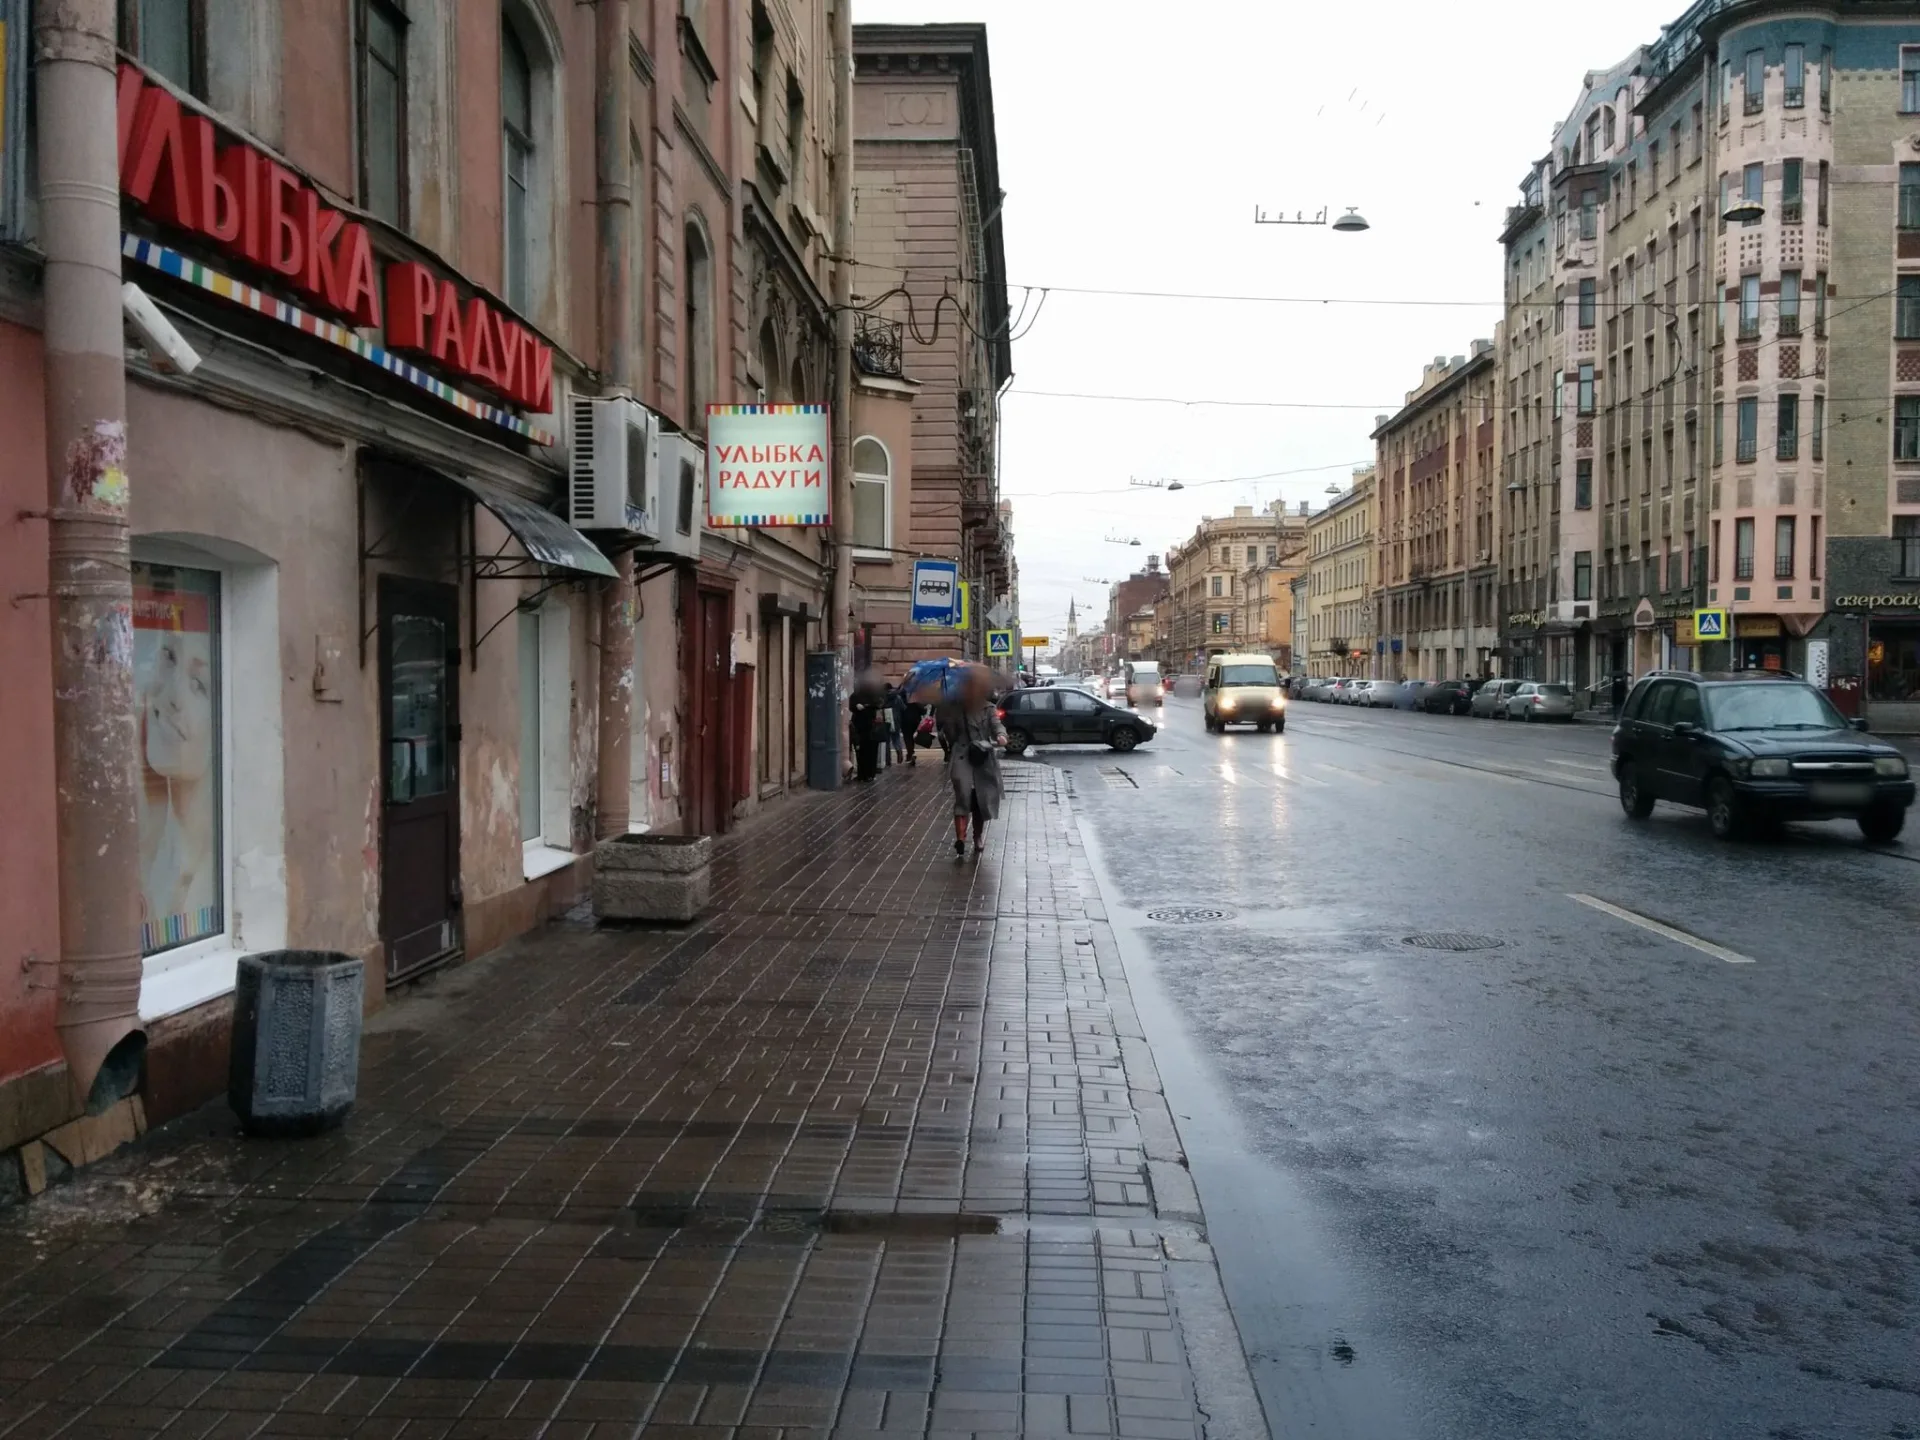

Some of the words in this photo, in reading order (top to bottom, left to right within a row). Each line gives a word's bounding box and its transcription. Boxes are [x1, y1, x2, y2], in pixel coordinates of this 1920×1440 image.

[388, 261, 553, 414] РАДУГИ
[714, 444, 824, 464] УЛЫБКА
[718, 469, 820, 489] РАДУГИ
[1835, 592, 1920, 609] азербай
